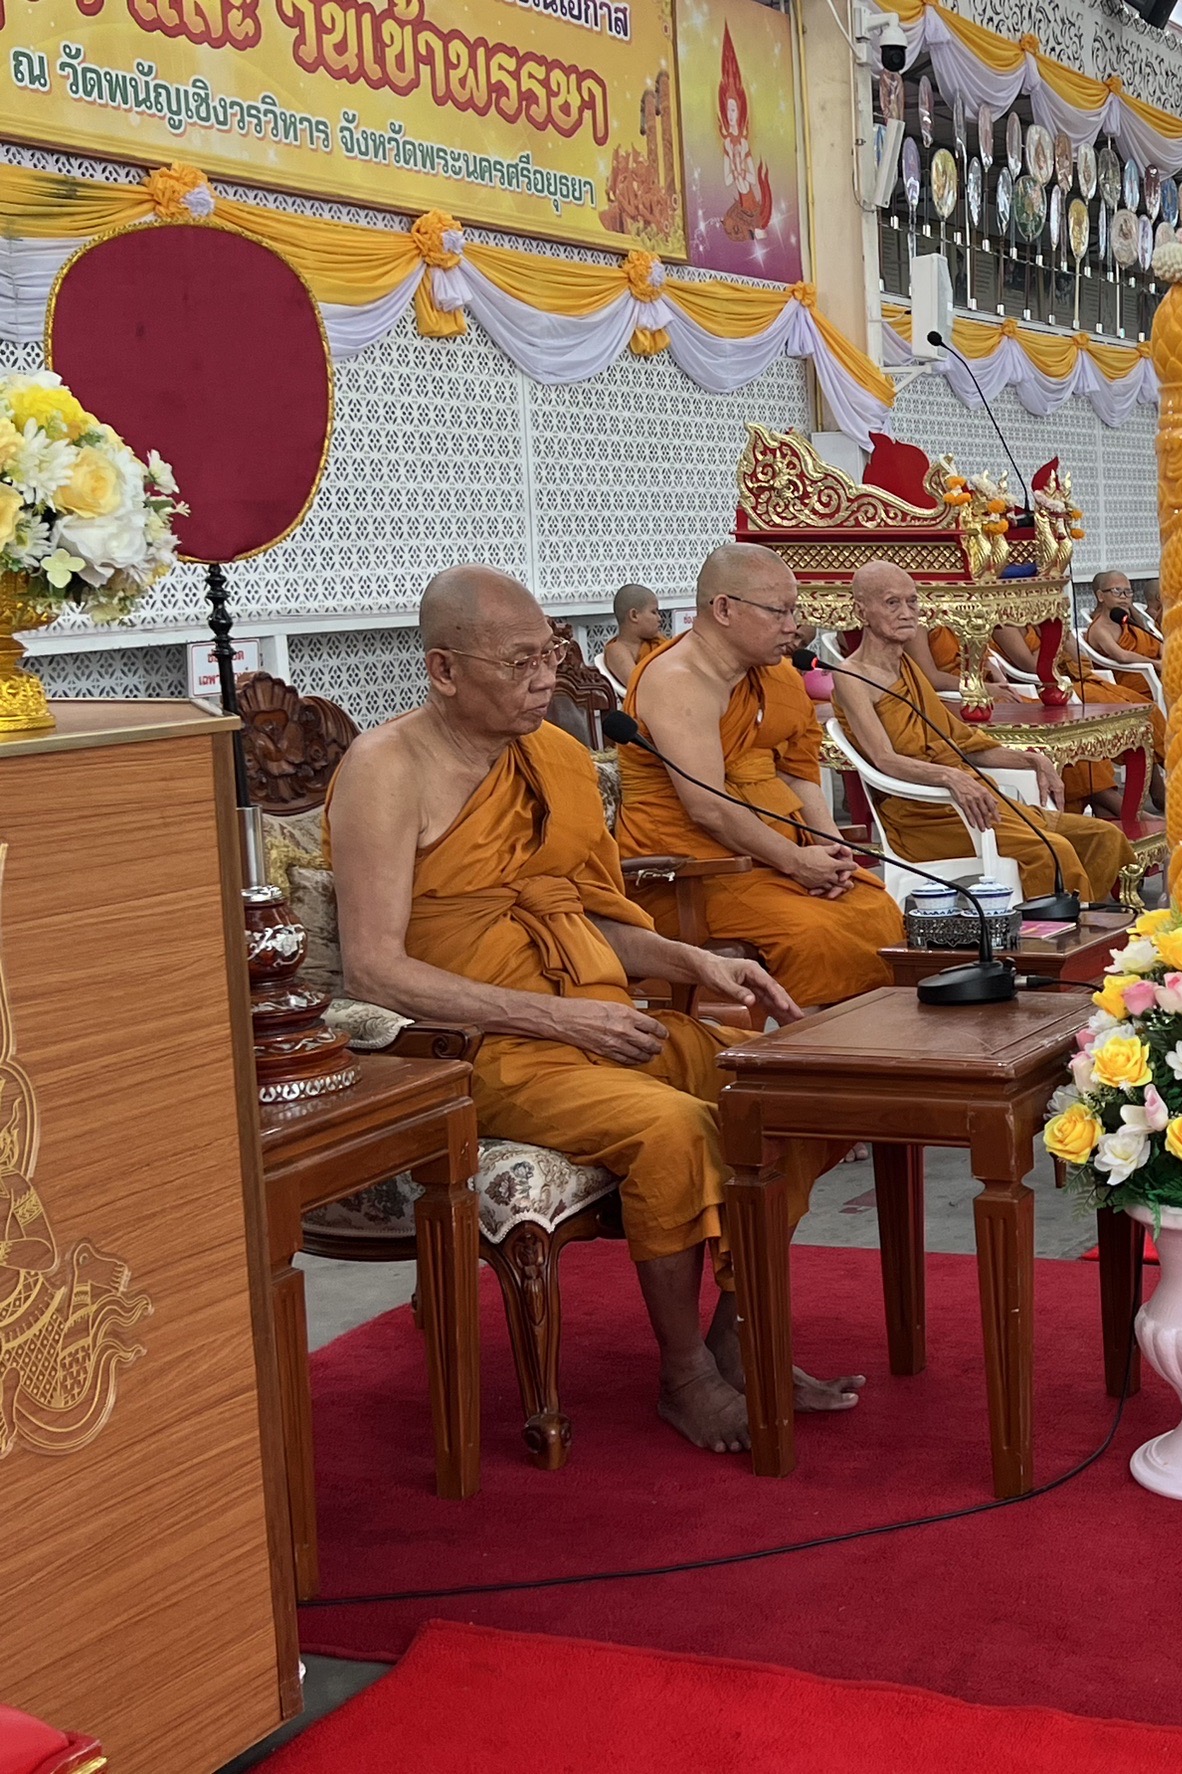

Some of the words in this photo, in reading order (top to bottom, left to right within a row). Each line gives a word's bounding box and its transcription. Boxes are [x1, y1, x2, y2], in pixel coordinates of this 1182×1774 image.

[12, 49, 48, 89] ณ
[58, 43, 331, 150] วัดพนัญเชิงวรวิหาร
[338, 110, 596, 213] จังหวัดพระนครศรีอยุธยา
